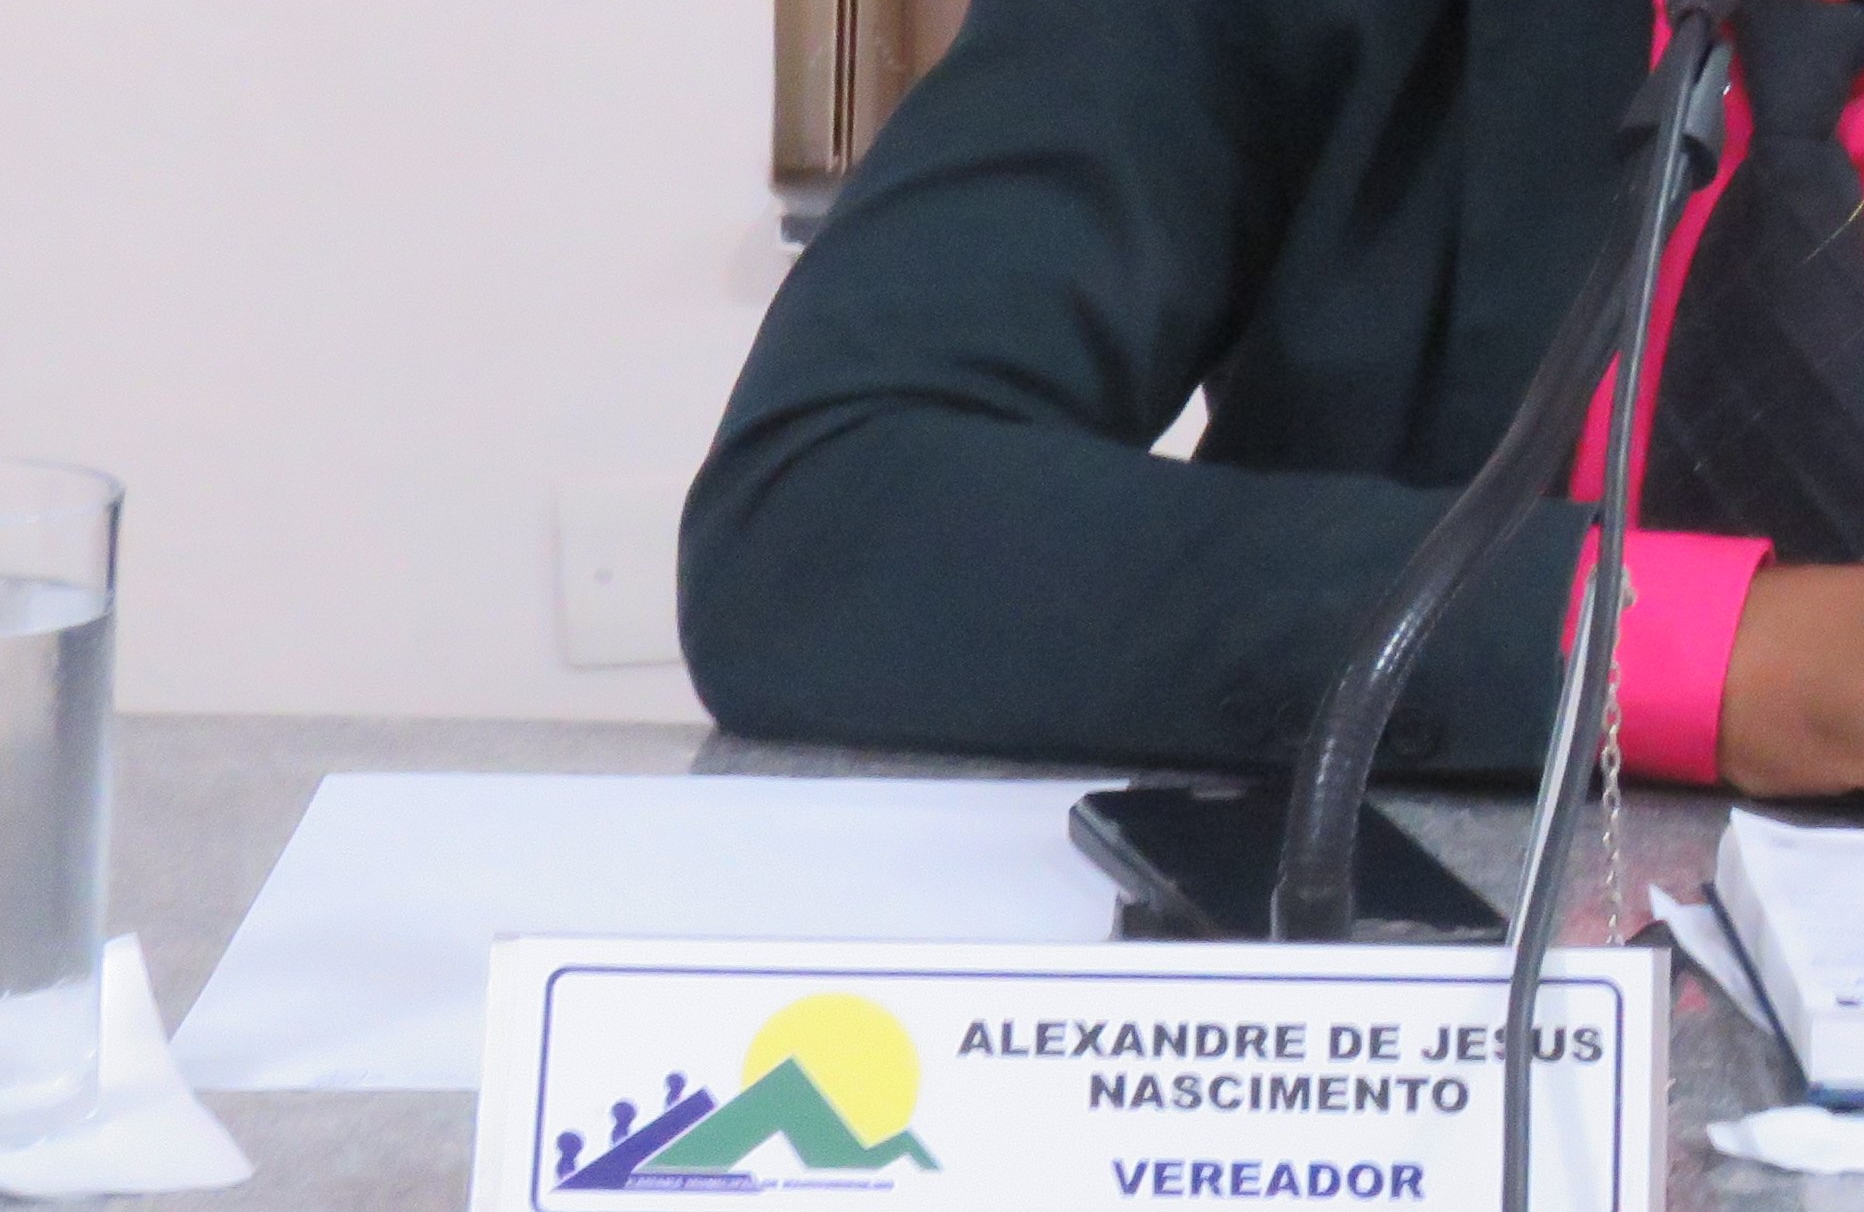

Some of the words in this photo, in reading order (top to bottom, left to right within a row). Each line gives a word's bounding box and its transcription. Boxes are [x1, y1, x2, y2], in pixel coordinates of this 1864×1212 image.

[958, 1021, 1304, 1058] ALEXANDRE
[1329, 1025, 1400, 1059] DE
[1090, 1074, 1469, 1113] NASCIMENTO
[1114, 1161, 1424, 1199] VEREADOR
